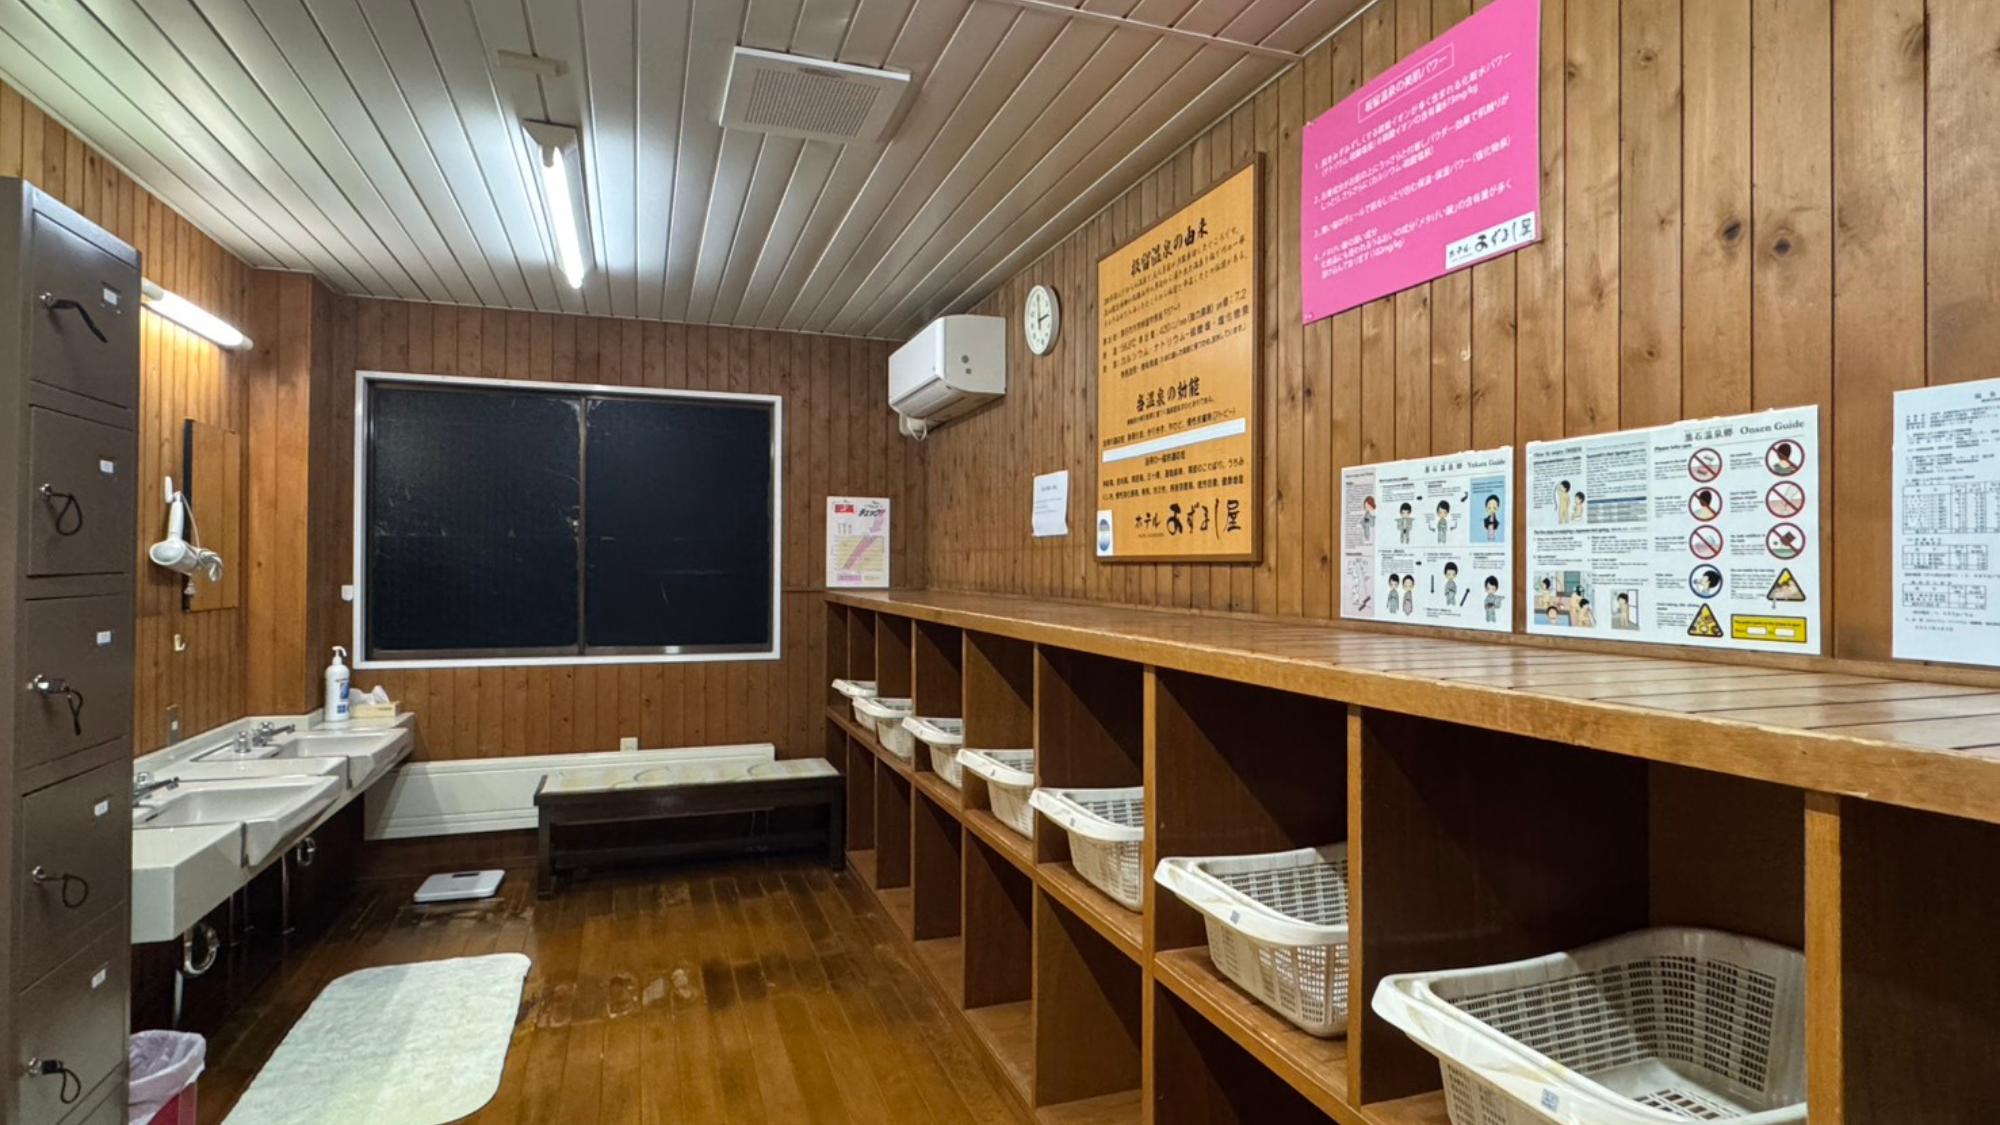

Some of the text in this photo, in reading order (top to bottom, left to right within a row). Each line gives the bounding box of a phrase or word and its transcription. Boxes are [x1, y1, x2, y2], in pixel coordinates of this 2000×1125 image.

[1740, 425, 1771, 435] Onsen
[1774, 420, 1805, 433] Guide
[1489, 459, 1505, 467] Guide
[1135, 511, 1160, 528] ホテル
